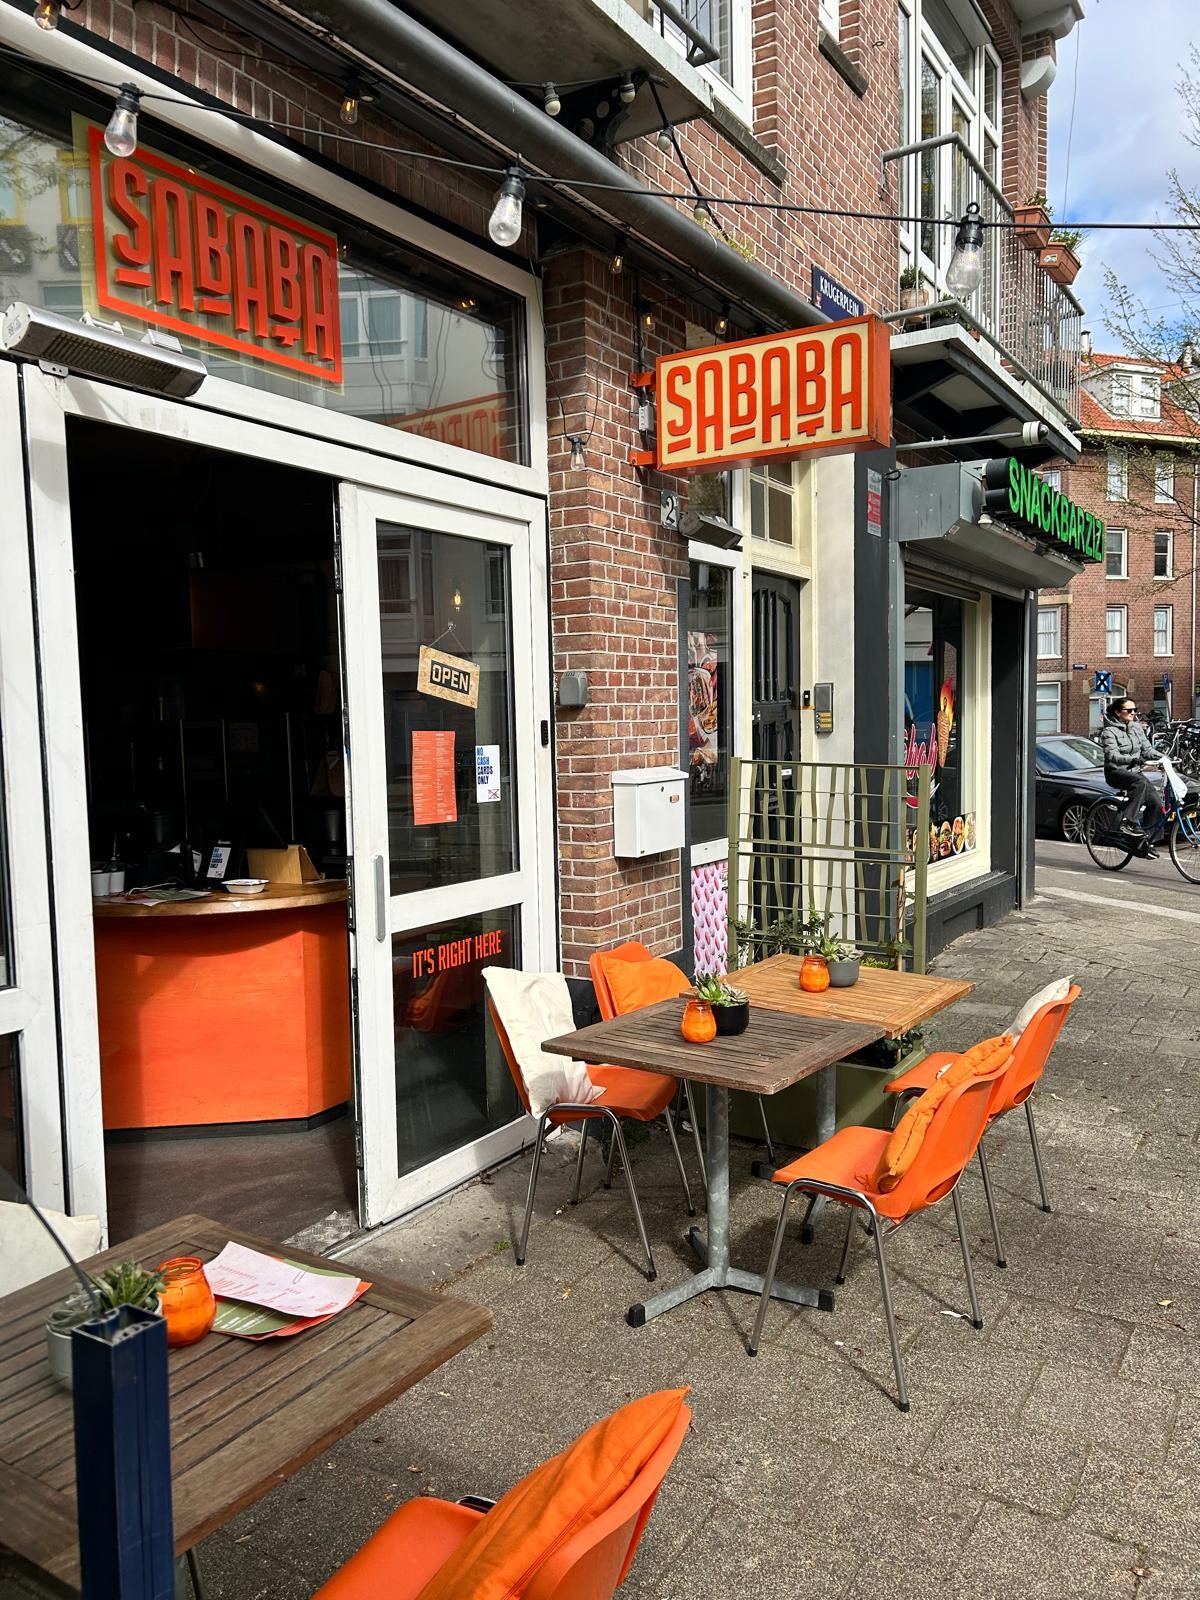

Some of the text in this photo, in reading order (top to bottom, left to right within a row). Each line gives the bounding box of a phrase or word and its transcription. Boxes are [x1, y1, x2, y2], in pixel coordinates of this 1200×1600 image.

[109, 158, 335, 361] SABABA
[820, 275, 859, 317] KRUGERPLEIN
[667, 332, 862, 454] SABABA
[666, 495, 676, 523] 2
[1008, 456, 1085, 553] SNACKBAR
[432, 663, 469, 692] OPEN
[476, 747, 484, 756] NO
[476, 756, 490, 766] CASH
[477, 766, 494, 775] CARDS
[477, 775, 490, 785] ONLY
[412, 929, 502, 979] IT'S RIGHT HERE
